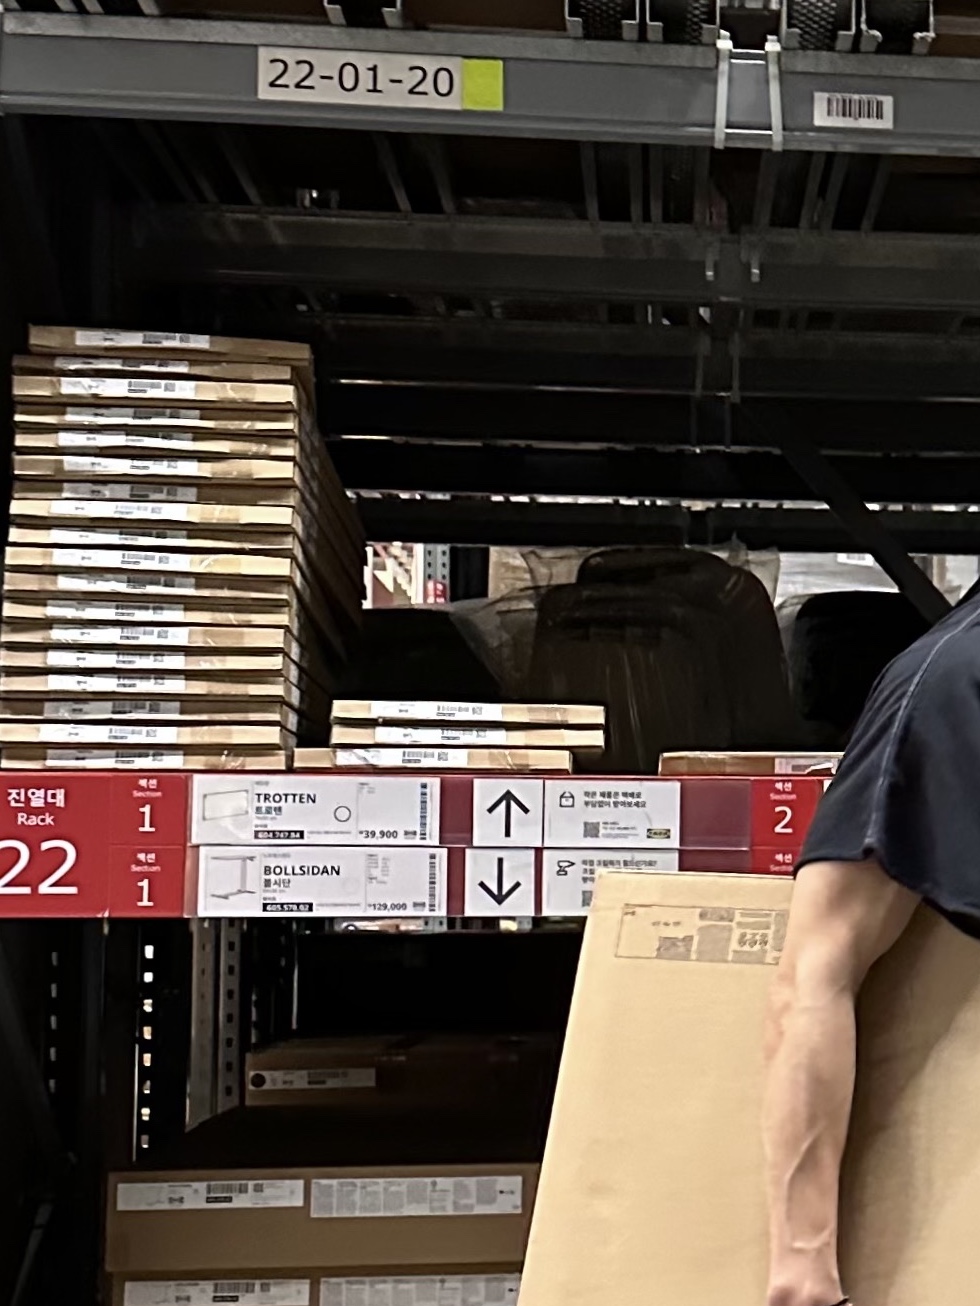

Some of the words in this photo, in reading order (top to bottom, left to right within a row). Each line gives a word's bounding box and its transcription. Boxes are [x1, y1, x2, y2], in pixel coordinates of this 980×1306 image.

[266, 57, 456, 98] 22-01-20
[7, 788, 66, 808] 진열대
[132, 789, 163, 798] Section
[255, 792, 317, 804] TROTTEN
[17, 812, 55, 826] Rack
[138, 804, 156, 832] 1
[774, 805, 793, 833] 2
[0, 839, 79, 895] 22
[130, 864, 161, 872] Section
[263, 865, 341, 876] BOLLSIDAN
[770, 864, 793, 872] Sectio
[136, 878, 154, 907] 1
